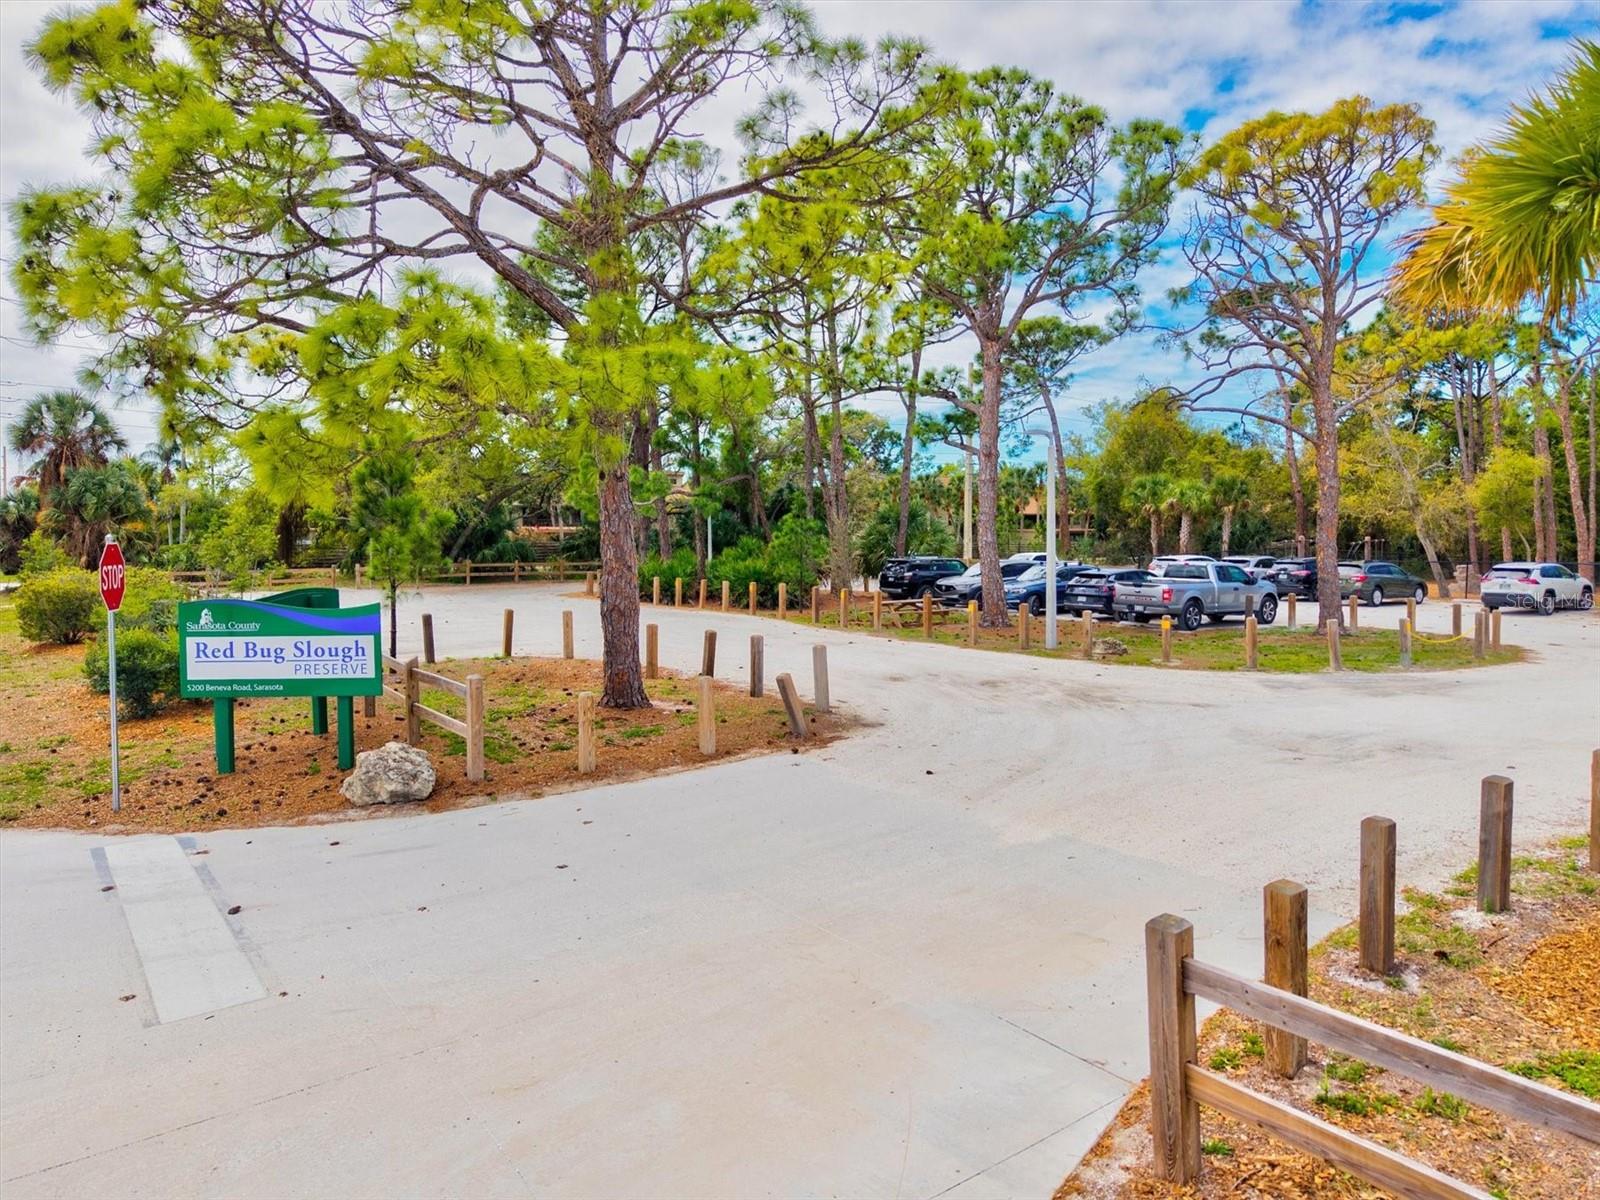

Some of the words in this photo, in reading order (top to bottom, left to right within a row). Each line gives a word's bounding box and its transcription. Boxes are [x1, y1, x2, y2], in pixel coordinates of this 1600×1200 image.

[102, 565, 123, 590] STOP
[186, 621, 226, 630] Sarasota
[228, 621, 260, 631] County
[195, 641, 235, 659] Red
[244, 641, 286, 664] Bug
[293, 640, 367, 663] Slough
[294, 663, 368, 675] PRESERVE
